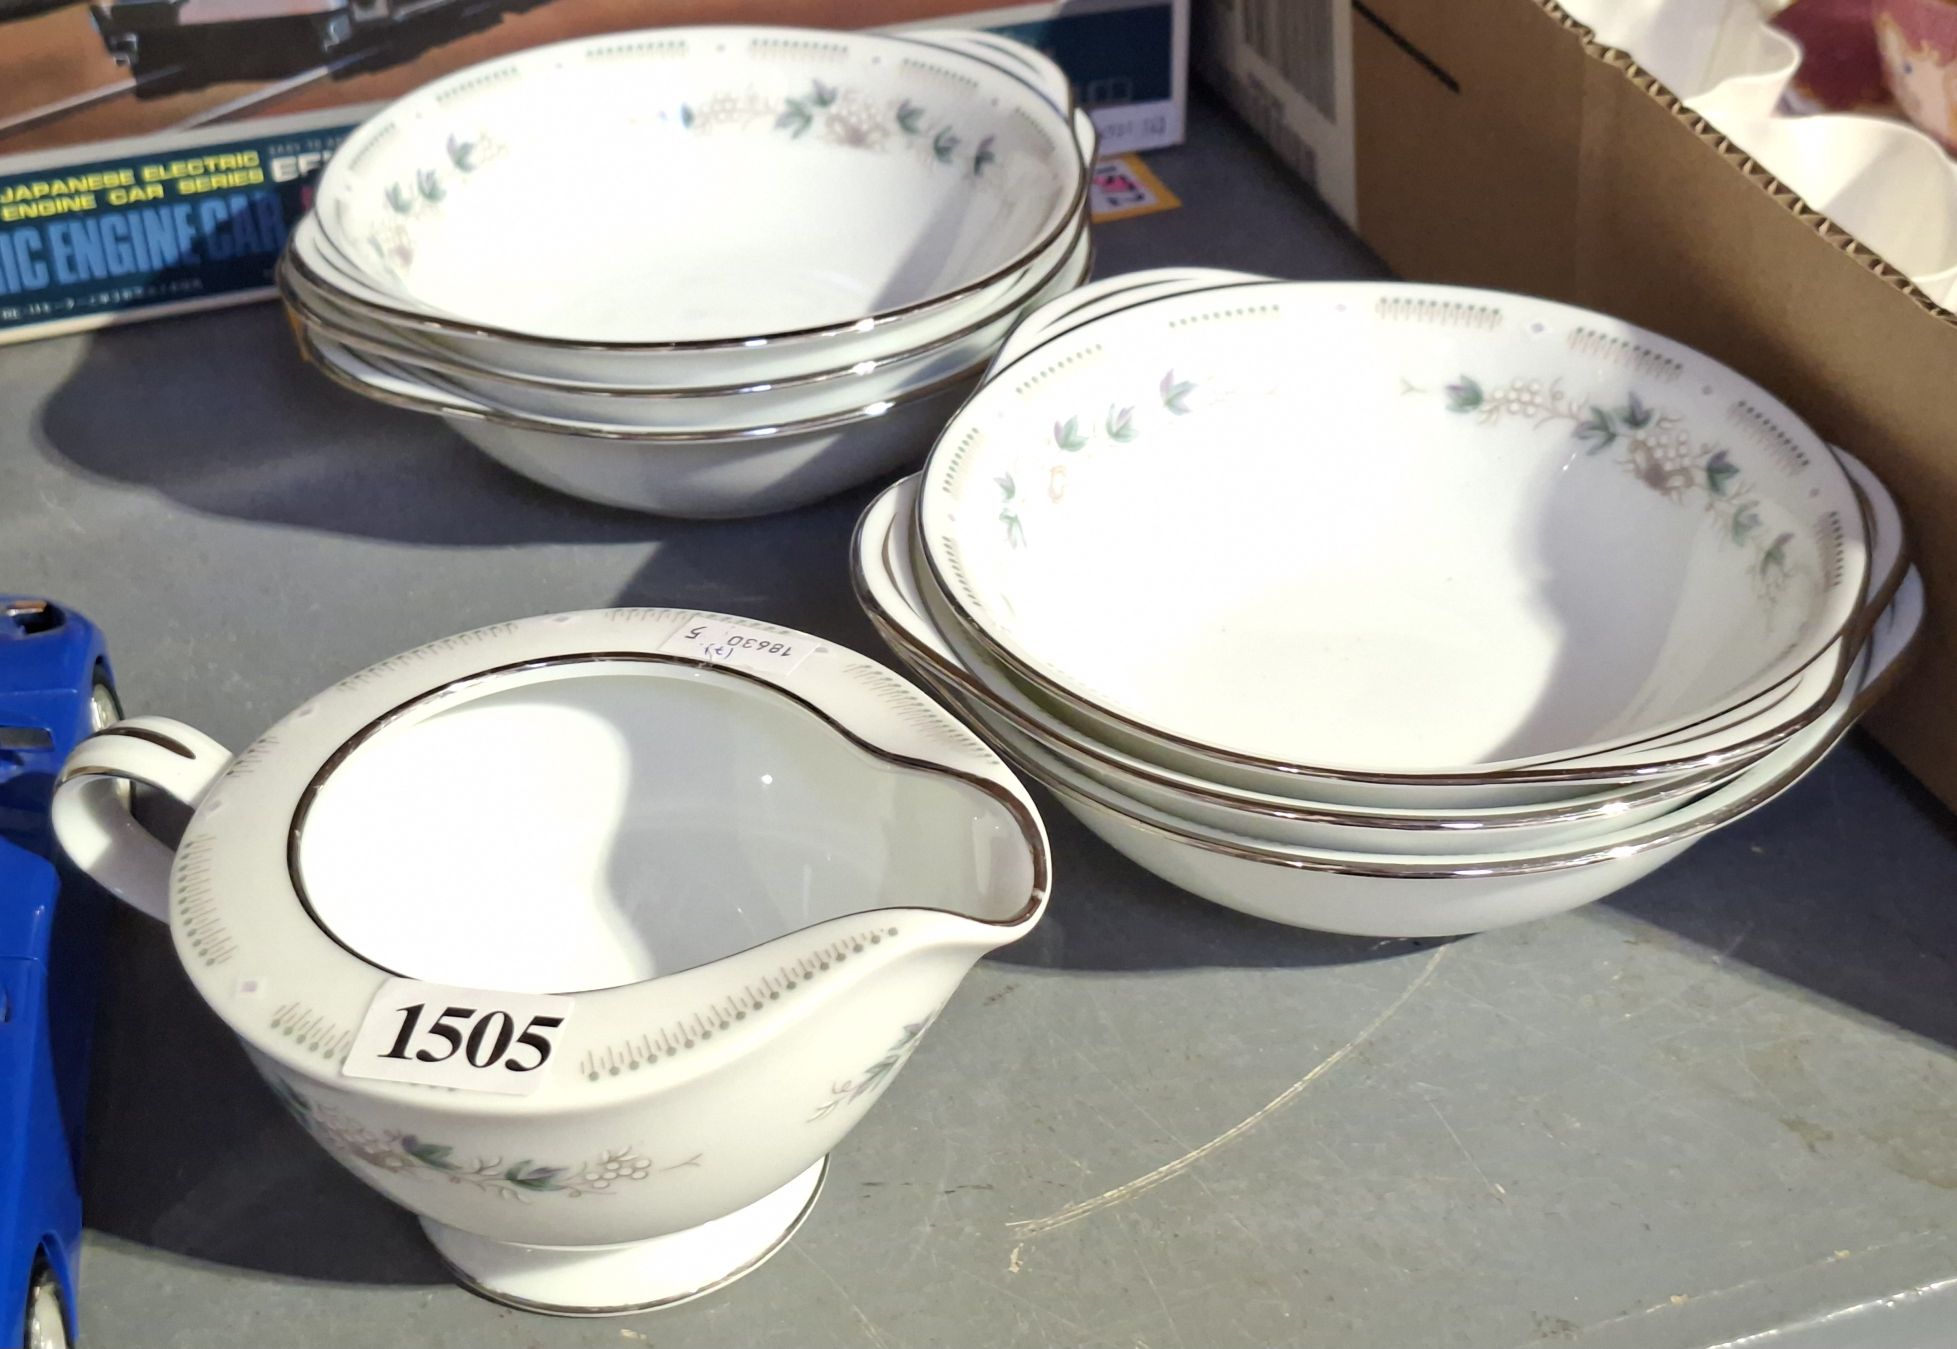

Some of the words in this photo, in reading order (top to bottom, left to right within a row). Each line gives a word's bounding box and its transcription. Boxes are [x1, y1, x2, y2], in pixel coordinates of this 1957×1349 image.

[0, 168, 136, 201] JAPANESE
[142, 151, 260, 182] ELECTRIC
[2, 191, 97, 222] ENGINE
[107, 183, 164, 206] CAR
[177, 167, 264, 195] SERIES
[0, 226, 49, 294] IC
[48, 203, 201, 286] ENGINE
[201, 190, 288, 261] CAR
[684, 626, 708, 640] 5
[727, 635, 793, 657] 18630
[376, 1003, 565, 1072] 1505
